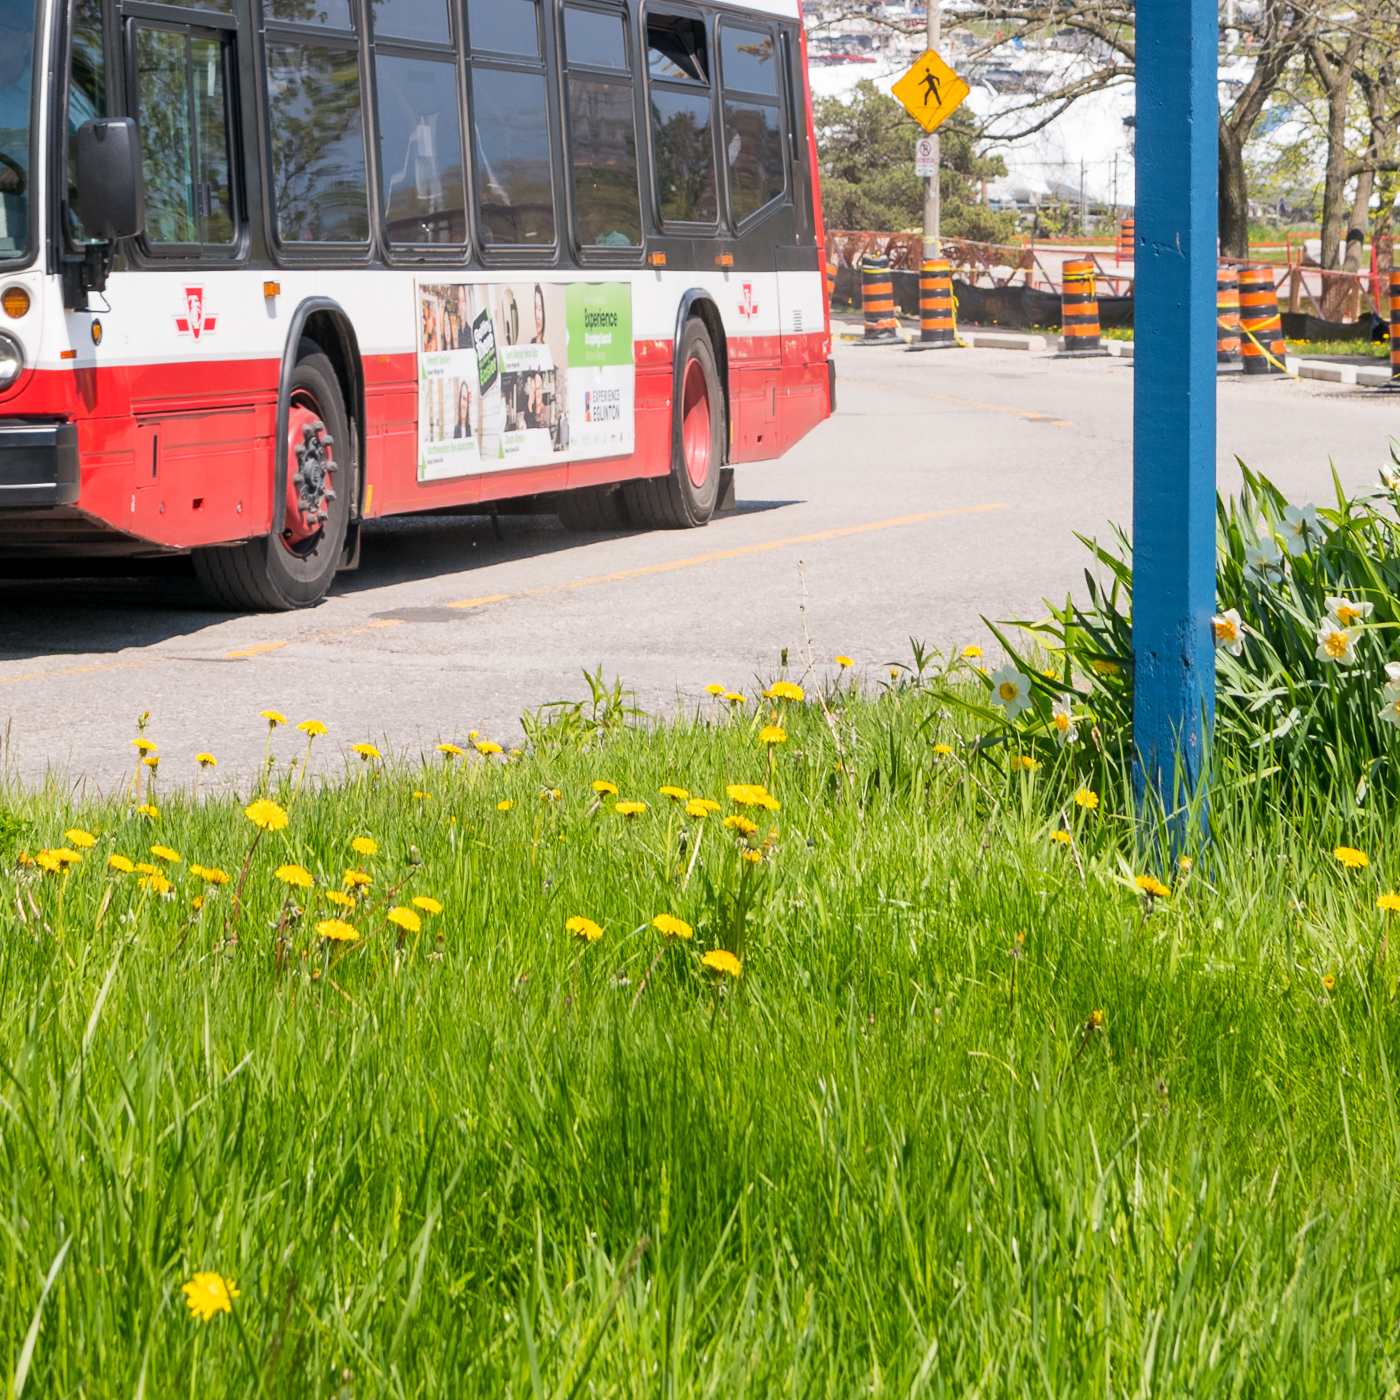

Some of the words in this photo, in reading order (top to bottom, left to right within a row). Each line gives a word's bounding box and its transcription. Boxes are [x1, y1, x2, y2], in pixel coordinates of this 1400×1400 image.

[584, 308, 618, 331] Experience
[593, 389, 620, 403] EXPERIENCE
[593, 404, 620, 422] EGLINTON
